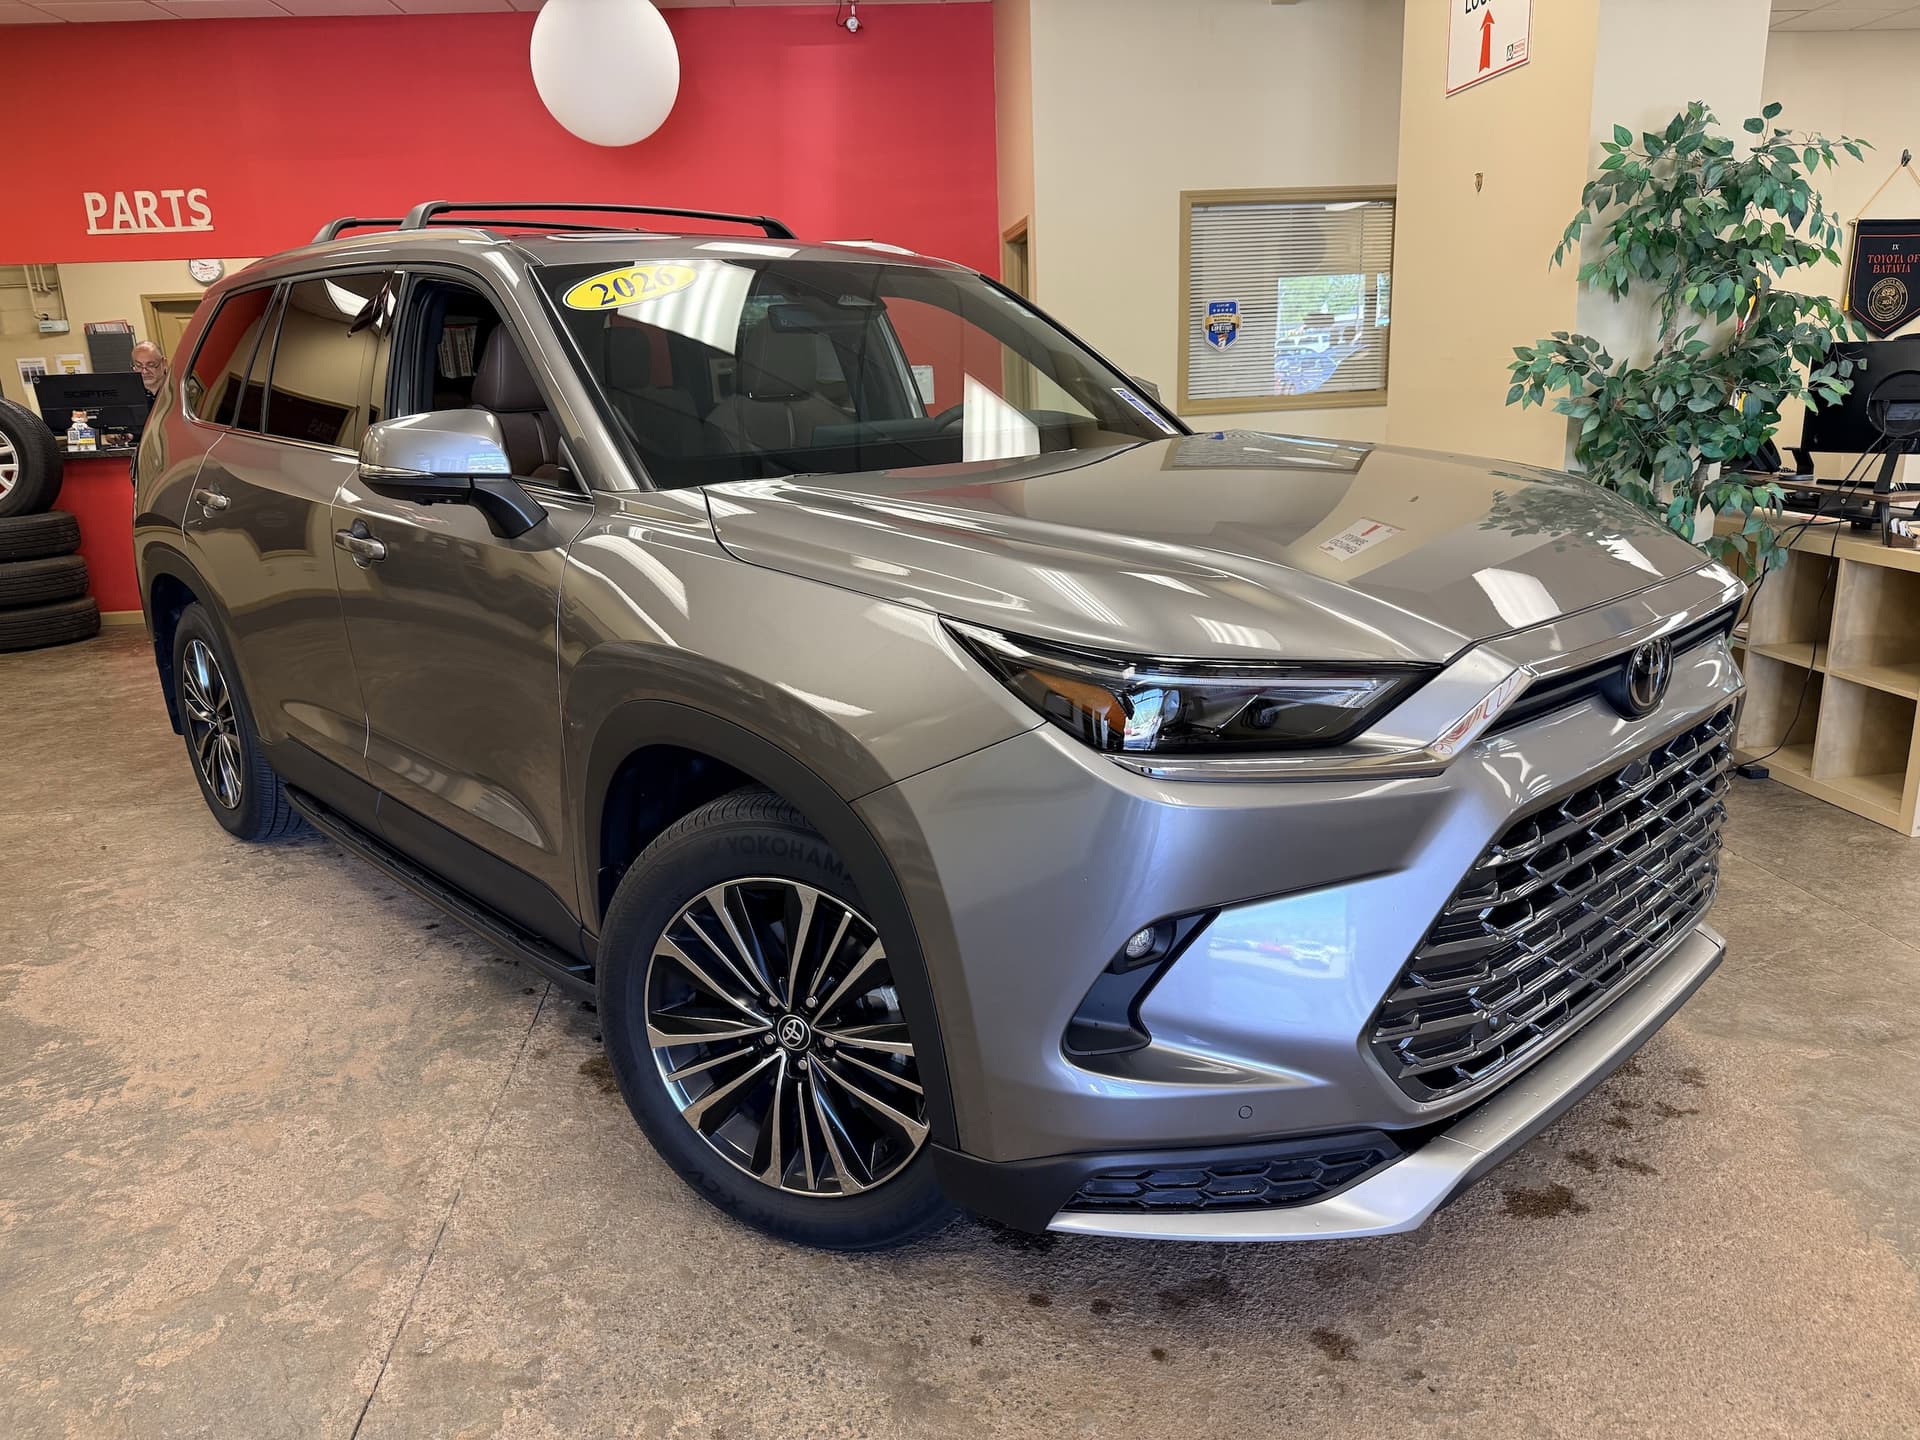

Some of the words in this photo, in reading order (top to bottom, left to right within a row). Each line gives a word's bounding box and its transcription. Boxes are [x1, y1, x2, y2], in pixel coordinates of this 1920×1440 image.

[83, 188, 213, 232] PARTS
[1868, 254, 1904, 264] TOYOTA
[1907, 253, 1920, 264] OF
[1873, 264, 1911, 273] BATAVIA
[590, 267, 675, 306] 2026
